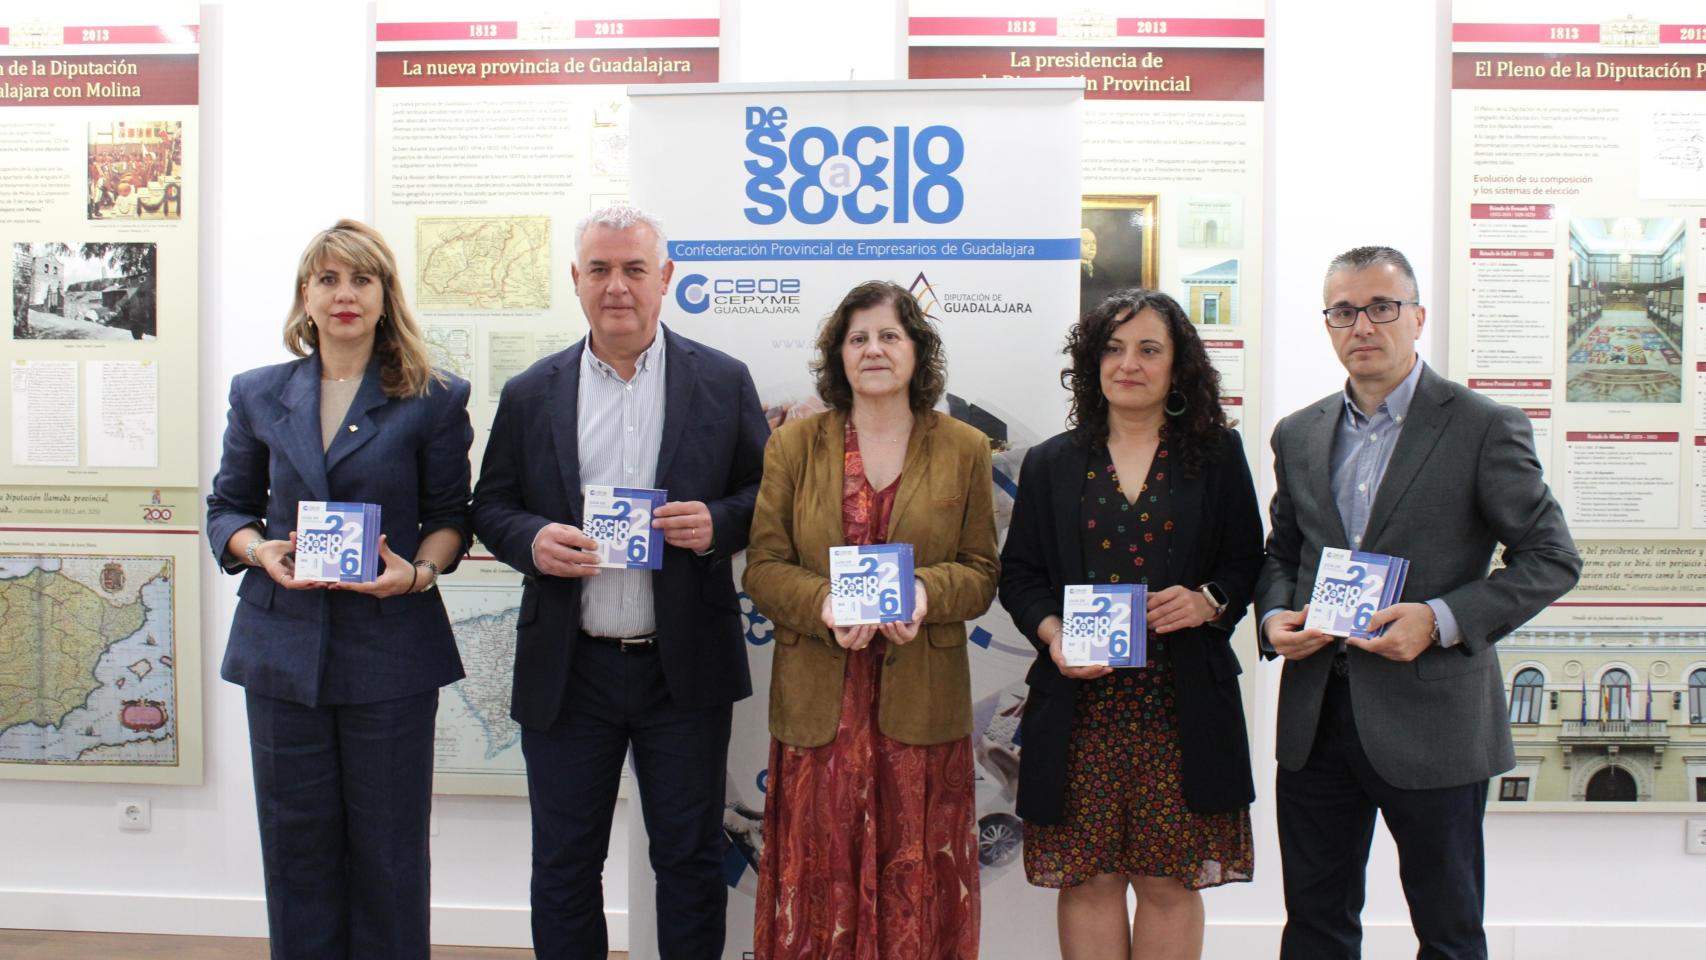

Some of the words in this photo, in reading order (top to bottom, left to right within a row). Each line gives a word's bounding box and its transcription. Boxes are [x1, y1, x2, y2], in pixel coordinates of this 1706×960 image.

[470, 24, 497, 37] 1813
[595, 23, 624, 36] 2013
[1007, 20, 1036, 33] 1813
[1137, 21, 1167, 34] 2013
[82, 29, 109, 41] 2013
[1550, 28, 1579, 40] 1813
[403, 60, 421, 76] La
[427, 61, 476, 75] nueva
[481, 57, 559, 79] provincia
[564, 56, 584, 74] de
[589, 56, 691, 76] Guadalajara
[1010, 52, 1030, 68] La
[1035, 52, 1137, 71] presidencia
[1142, 52, 1163, 68] de
[9, 60, 28, 75] de
[32, 60, 46, 75] la
[50, 59, 137, 79] Diputación
[1475, 61, 1492, 77] El
[1496, 61, 1546, 77] Pleno
[1550, 61, 1571, 77] de
[1576, 62, 1591, 78] la
[1596, 61, 1691, 82] Diputación
[53, 86, 82, 97] con
[86, 82, 141, 97] Molina
[1103, 75, 1191, 92] Provincial
[1473, 174, 1514, 184] Evolución
[1516, 174, 1527, 184] de
[1541, 174, 1593, 186] composición
[1473, 188, 1479, 196] y
[1480, 186, 1493, 195] los
[1495, 186, 1531, 195] sistemas
[1533, 186, 1543, 195] de
[1545, 186, 1580, 195] elección
[675, 242, 768, 257] Confederación
[771, 242, 833, 256] Provincial
[837, 242, 854, 256] de
[858, 242, 936, 259] Empresarios
[941, 242, 958, 256] de
[961, 242, 1035, 258] Guadalajara
[714, 296, 800, 305] CEPYME
[944, 293, 989, 301] DIPUTACIÓN
[714, 305, 800, 314] GUADALAJARA
[944, 302, 1032, 314] GUADALAJARA
